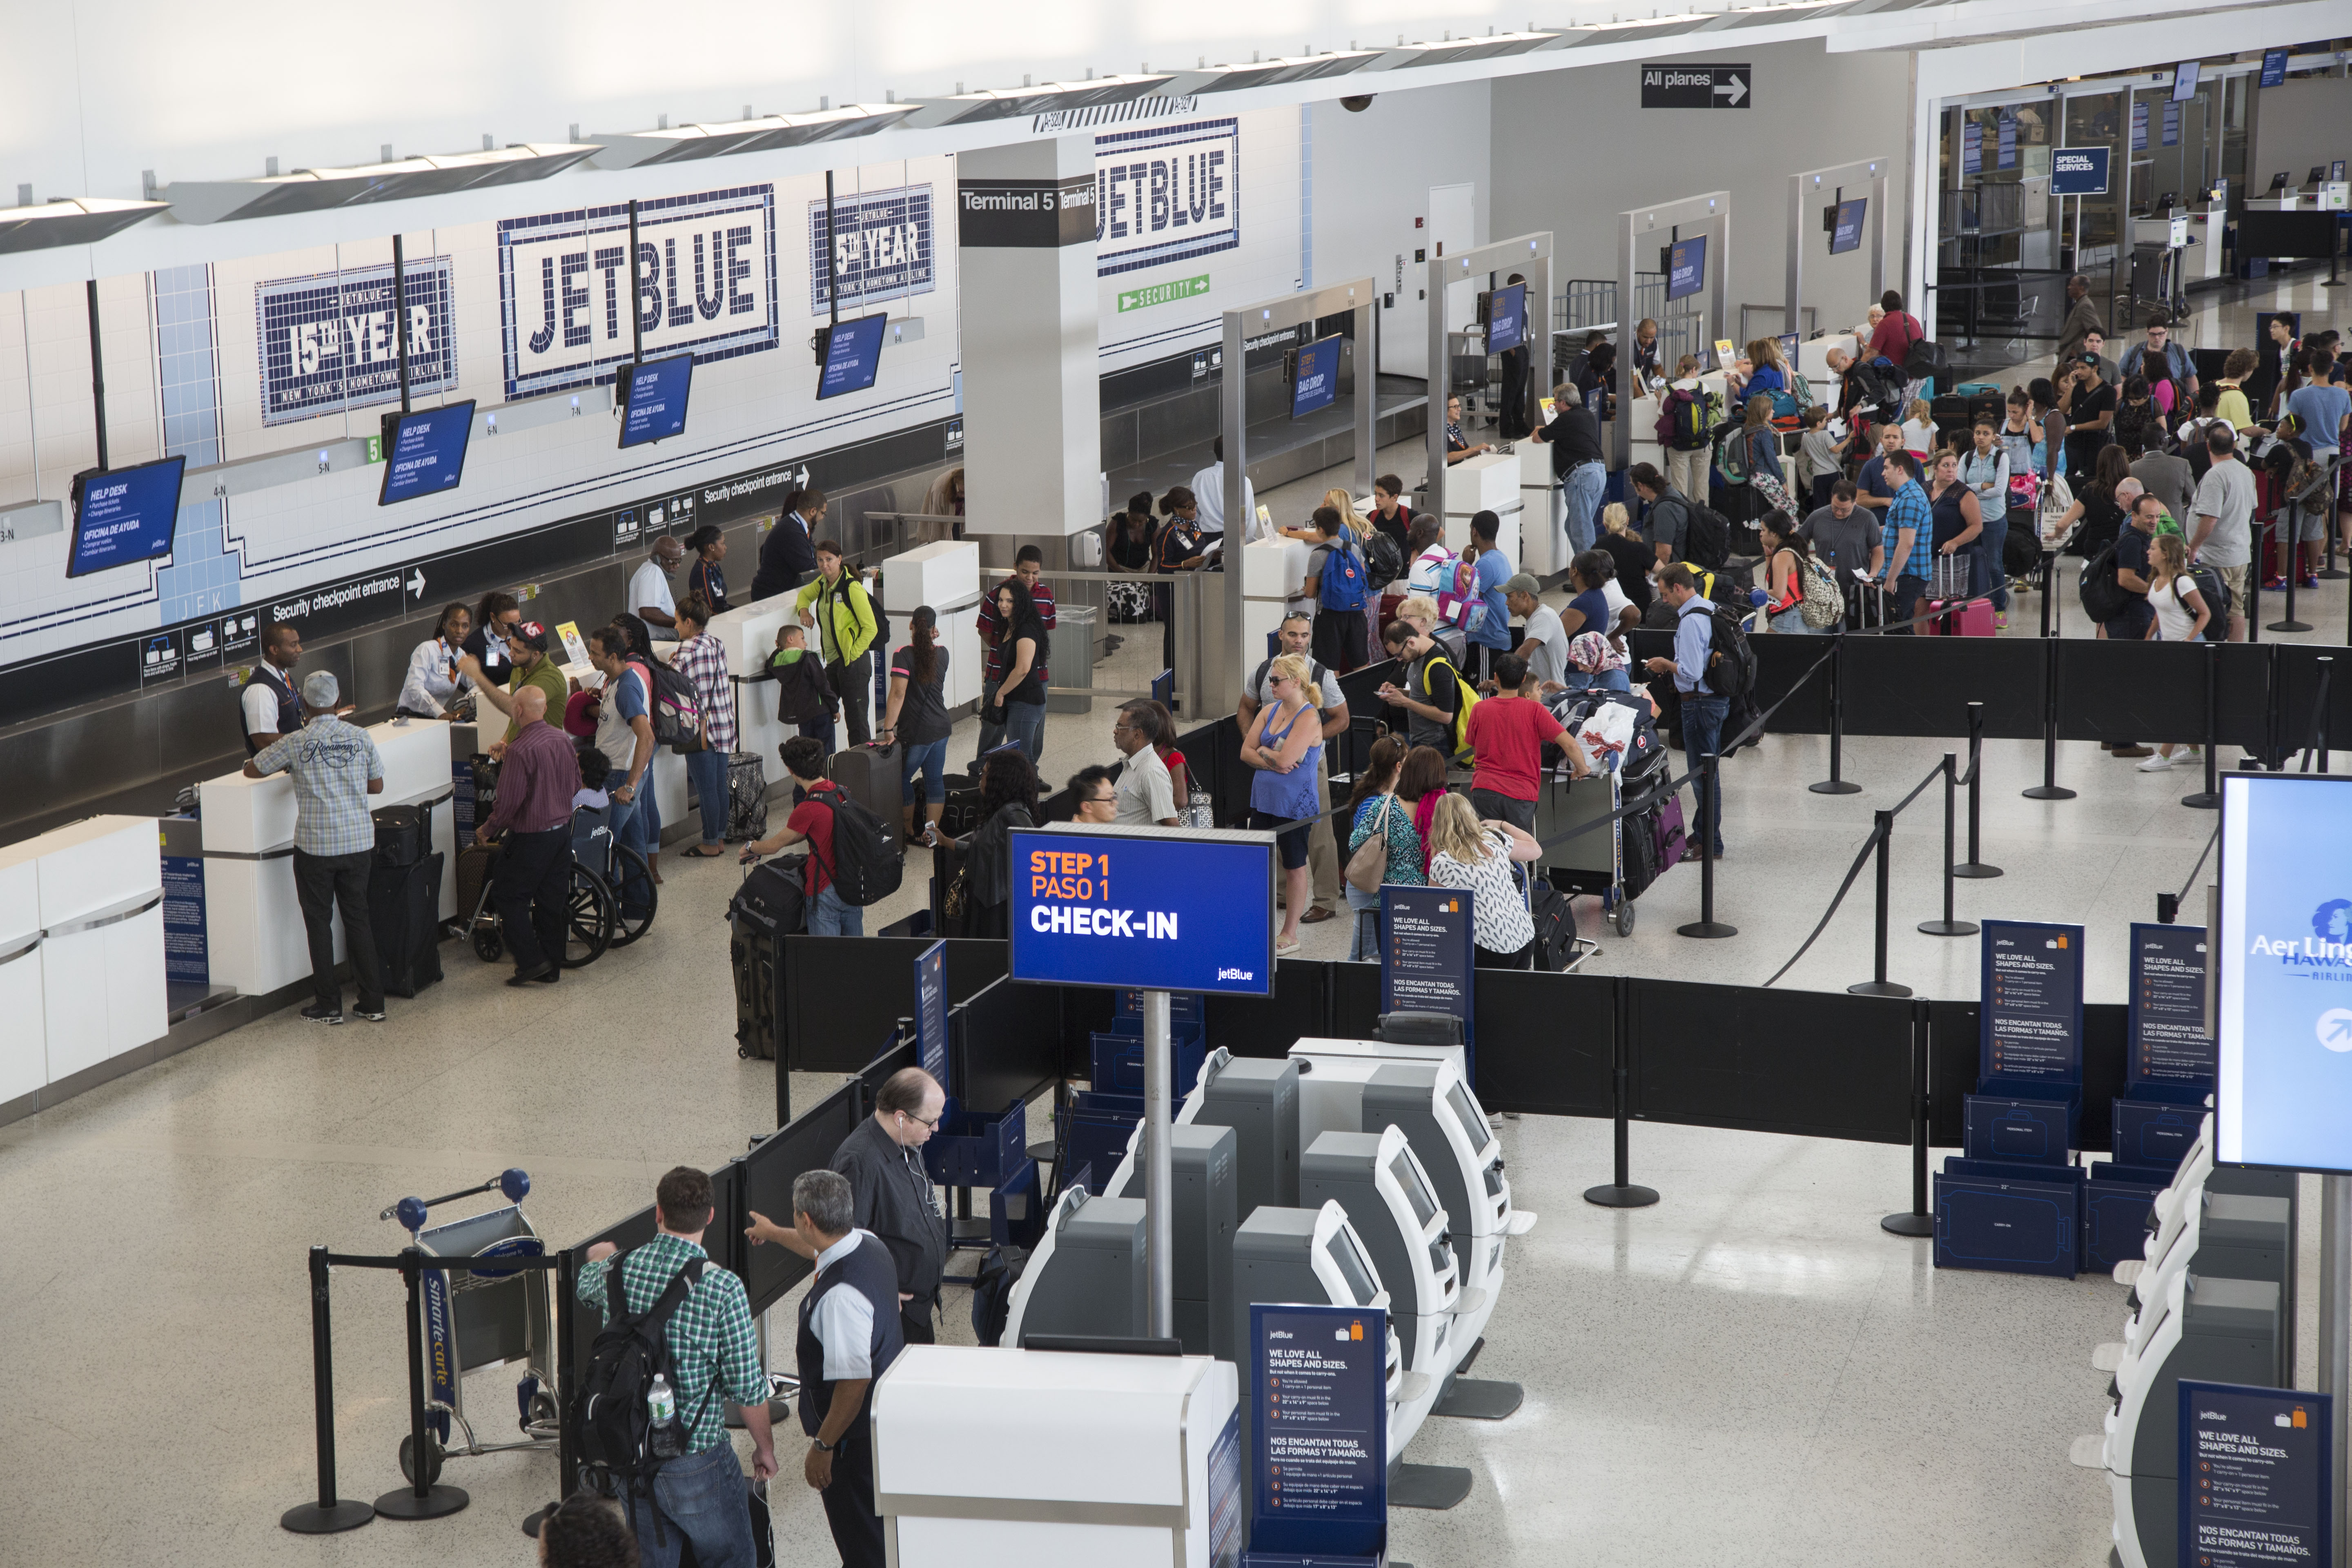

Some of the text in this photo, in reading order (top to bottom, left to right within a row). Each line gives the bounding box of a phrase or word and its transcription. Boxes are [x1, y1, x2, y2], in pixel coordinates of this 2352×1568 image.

[1644, 71, 1711, 89] All planes
[1045, 112, 1061, 127] A-320
[2056, 155, 2089, 163] SPECIAL
[2056, 163, 2093, 172] SERVICES
[961, 192, 1054, 210] Terminal 5
[1059, 187, 1094, 209] Terminal 5
[1096, 150, 1224, 243] JETBLUE
[862, 209, 887, 221] JETBLUE
[865, 222, 919, 270] YEAR
[867, 273, 896, 288] HOMETOWN
[528, 225, 754, 354] JETBLUE
[1140, 281, 1189, 306] SECURITY
[341, 290, 381, 305] JETBLUE
[834, 332, 855, 343] HELP DESK
[1245, 330, 1295, 352] Security checkpoint entrance
[290, 319, 339, 376] 15TH
[1301, 353, 1315, 366] STEP 2
[1300, 364, 1314, 377] PASO 2
[282, 390, 301, 402] NEW
[308, 381, 343, 396] YORK'S
[351, 372, 397, 389] HOMETOWN
[636, 373, 658, 386] HELP DESK
[1298, 374, 1324, 394] BAG DROP
[572, 407, 580, 416] 7-N
[631, 403, 664, 418] OFICINA DE AYUDA
[403, 423, 431, 438] HELP DESK
[488, 425, 497, 435] 6-N
[370, 439, 378, 461] 5
[319, 463, 330, 474] 5-N
[395, 455, 437, 473] OFICINA DE AYUDA
[91, 483, 127, 501] HELP DESK
[214, 486, 226, 497] 4-N
[705, 470, 791, 503] Security checkpoint entrance
[0, 529, 14, 542] 3-N
[84, 519, 139, 541] OFICINA DE AYUDA
[85, 540, 101, 548] Comprar
[152, 539, 165, 550] jetBlue
[274, 576, 399, 621] Security checkpoint entrance
[299, 738, 363, 768] Rocawear
[1031, 851, 1108, 875] STEP 1
[1032, 876, 1108, 901] PASO 1
[1031, 905, 1177, 940] CHECK-IN
[2250, 935, 2299, 956] Aer
[1218, 968, 1253, 980] jetBlue
[429, 1278, 448, 1386] smartecarte
[1270, 1331, 1293, 1339] jetBlue
[1270, 1349, 1283, 1358] WE
[1285, 1350, 1304, 1359] LOVE
[1270, 1359, 1347, 1369] SHAPES AND SIZES.
[2200, 1411, 2227, 1421] jetBlue
[1289, 1438, 1331, 1447] ENCANTAN
[1332, 1439, 1358, 1448] TODAS
[2198, 1430, 2259, 1445] WE LOVE ALL
[1287, 1448, 1320, 1456] FORMAS
[1328, 1448, 1368, 1458] TAMAÑOS.
[2199, 1441, 2288, 1458] SHAPES AND SIZES.
[2198, 1526, 2299, 1544] NOS ENCANTAN TODAS
[2200, 1535, 2310, 1556] LAS FORMAS Y TAMAÑOS.
